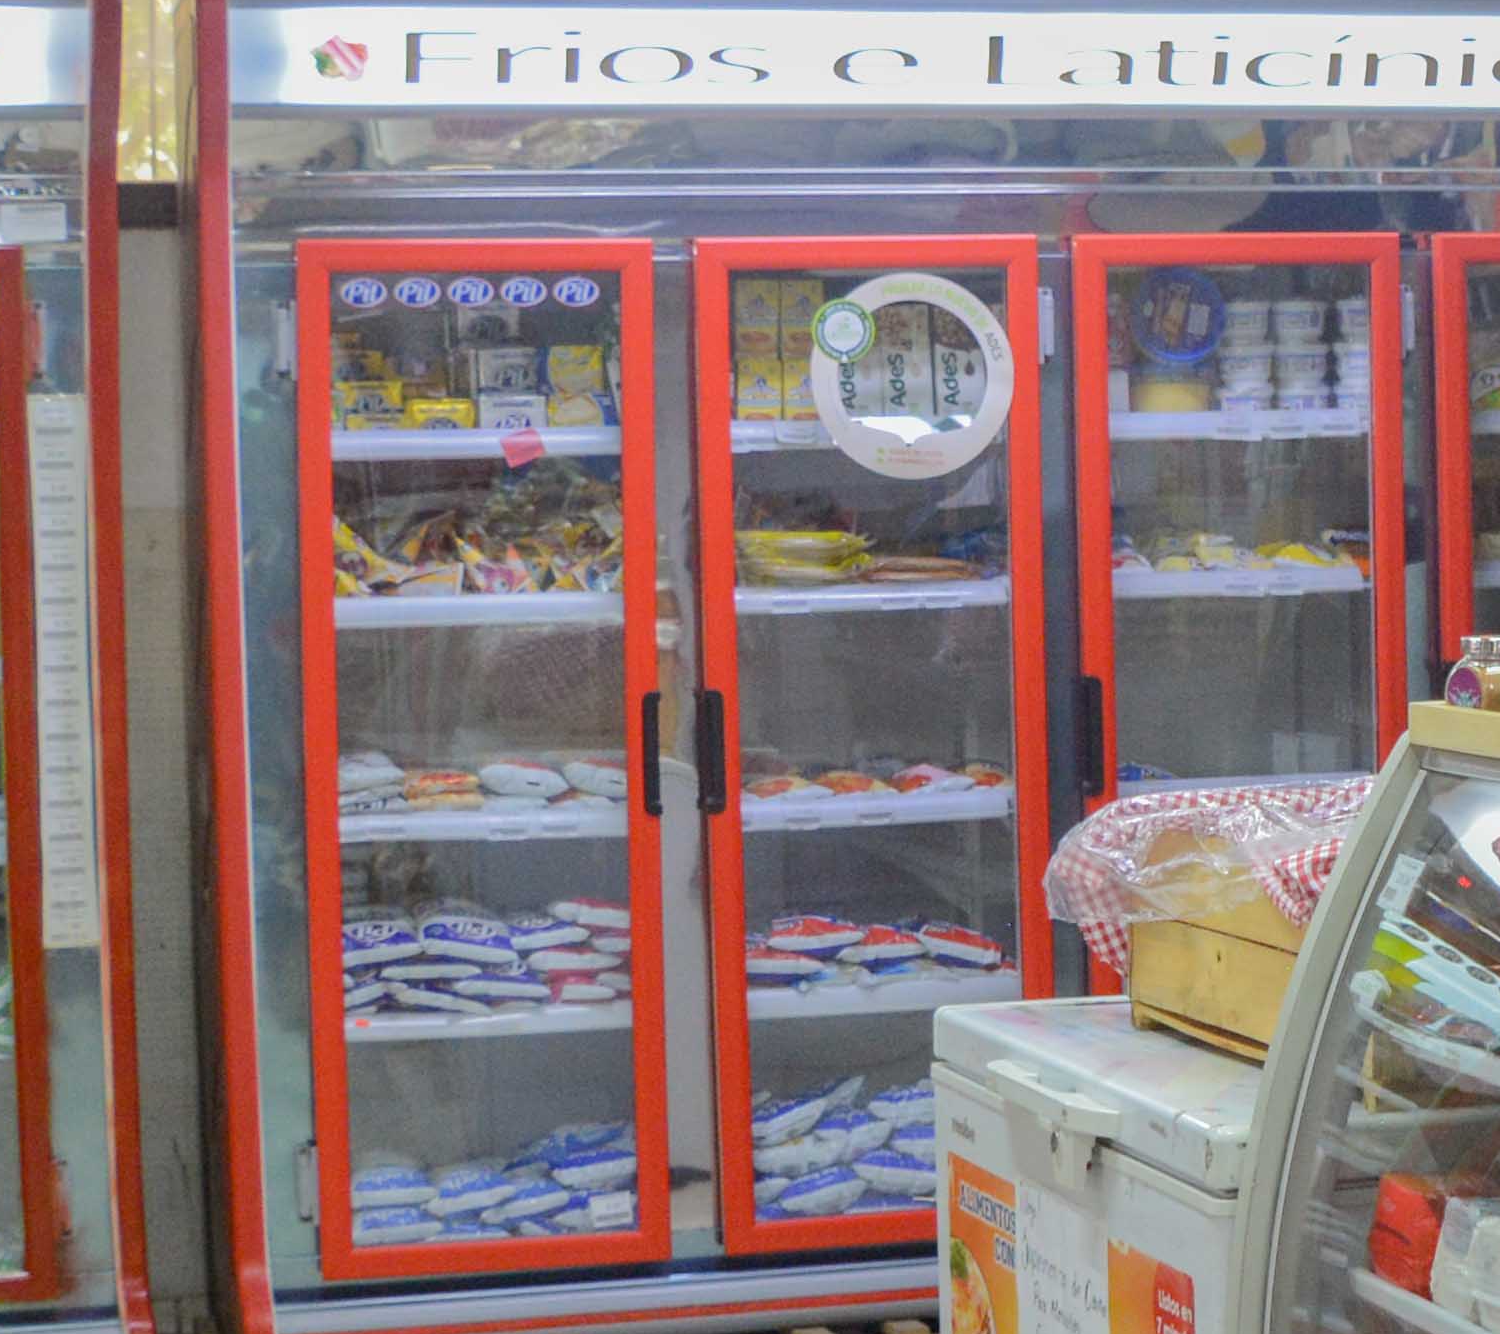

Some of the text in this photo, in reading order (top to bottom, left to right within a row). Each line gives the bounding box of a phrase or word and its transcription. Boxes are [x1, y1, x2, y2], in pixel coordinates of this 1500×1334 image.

[405, 30, 771, 85] Frios
[832, 47, 919, 85] e
[840, 362, 857, 410] Ade
[887, 353, 906, 407] AdeS
[942, 351, 961, 406] AdeS
[958, 1184, 1017, 1235] ALIMENTOS
[1156, 1317, 1164, 1334] 7
[1180, 1304, 1194, 1324] en
